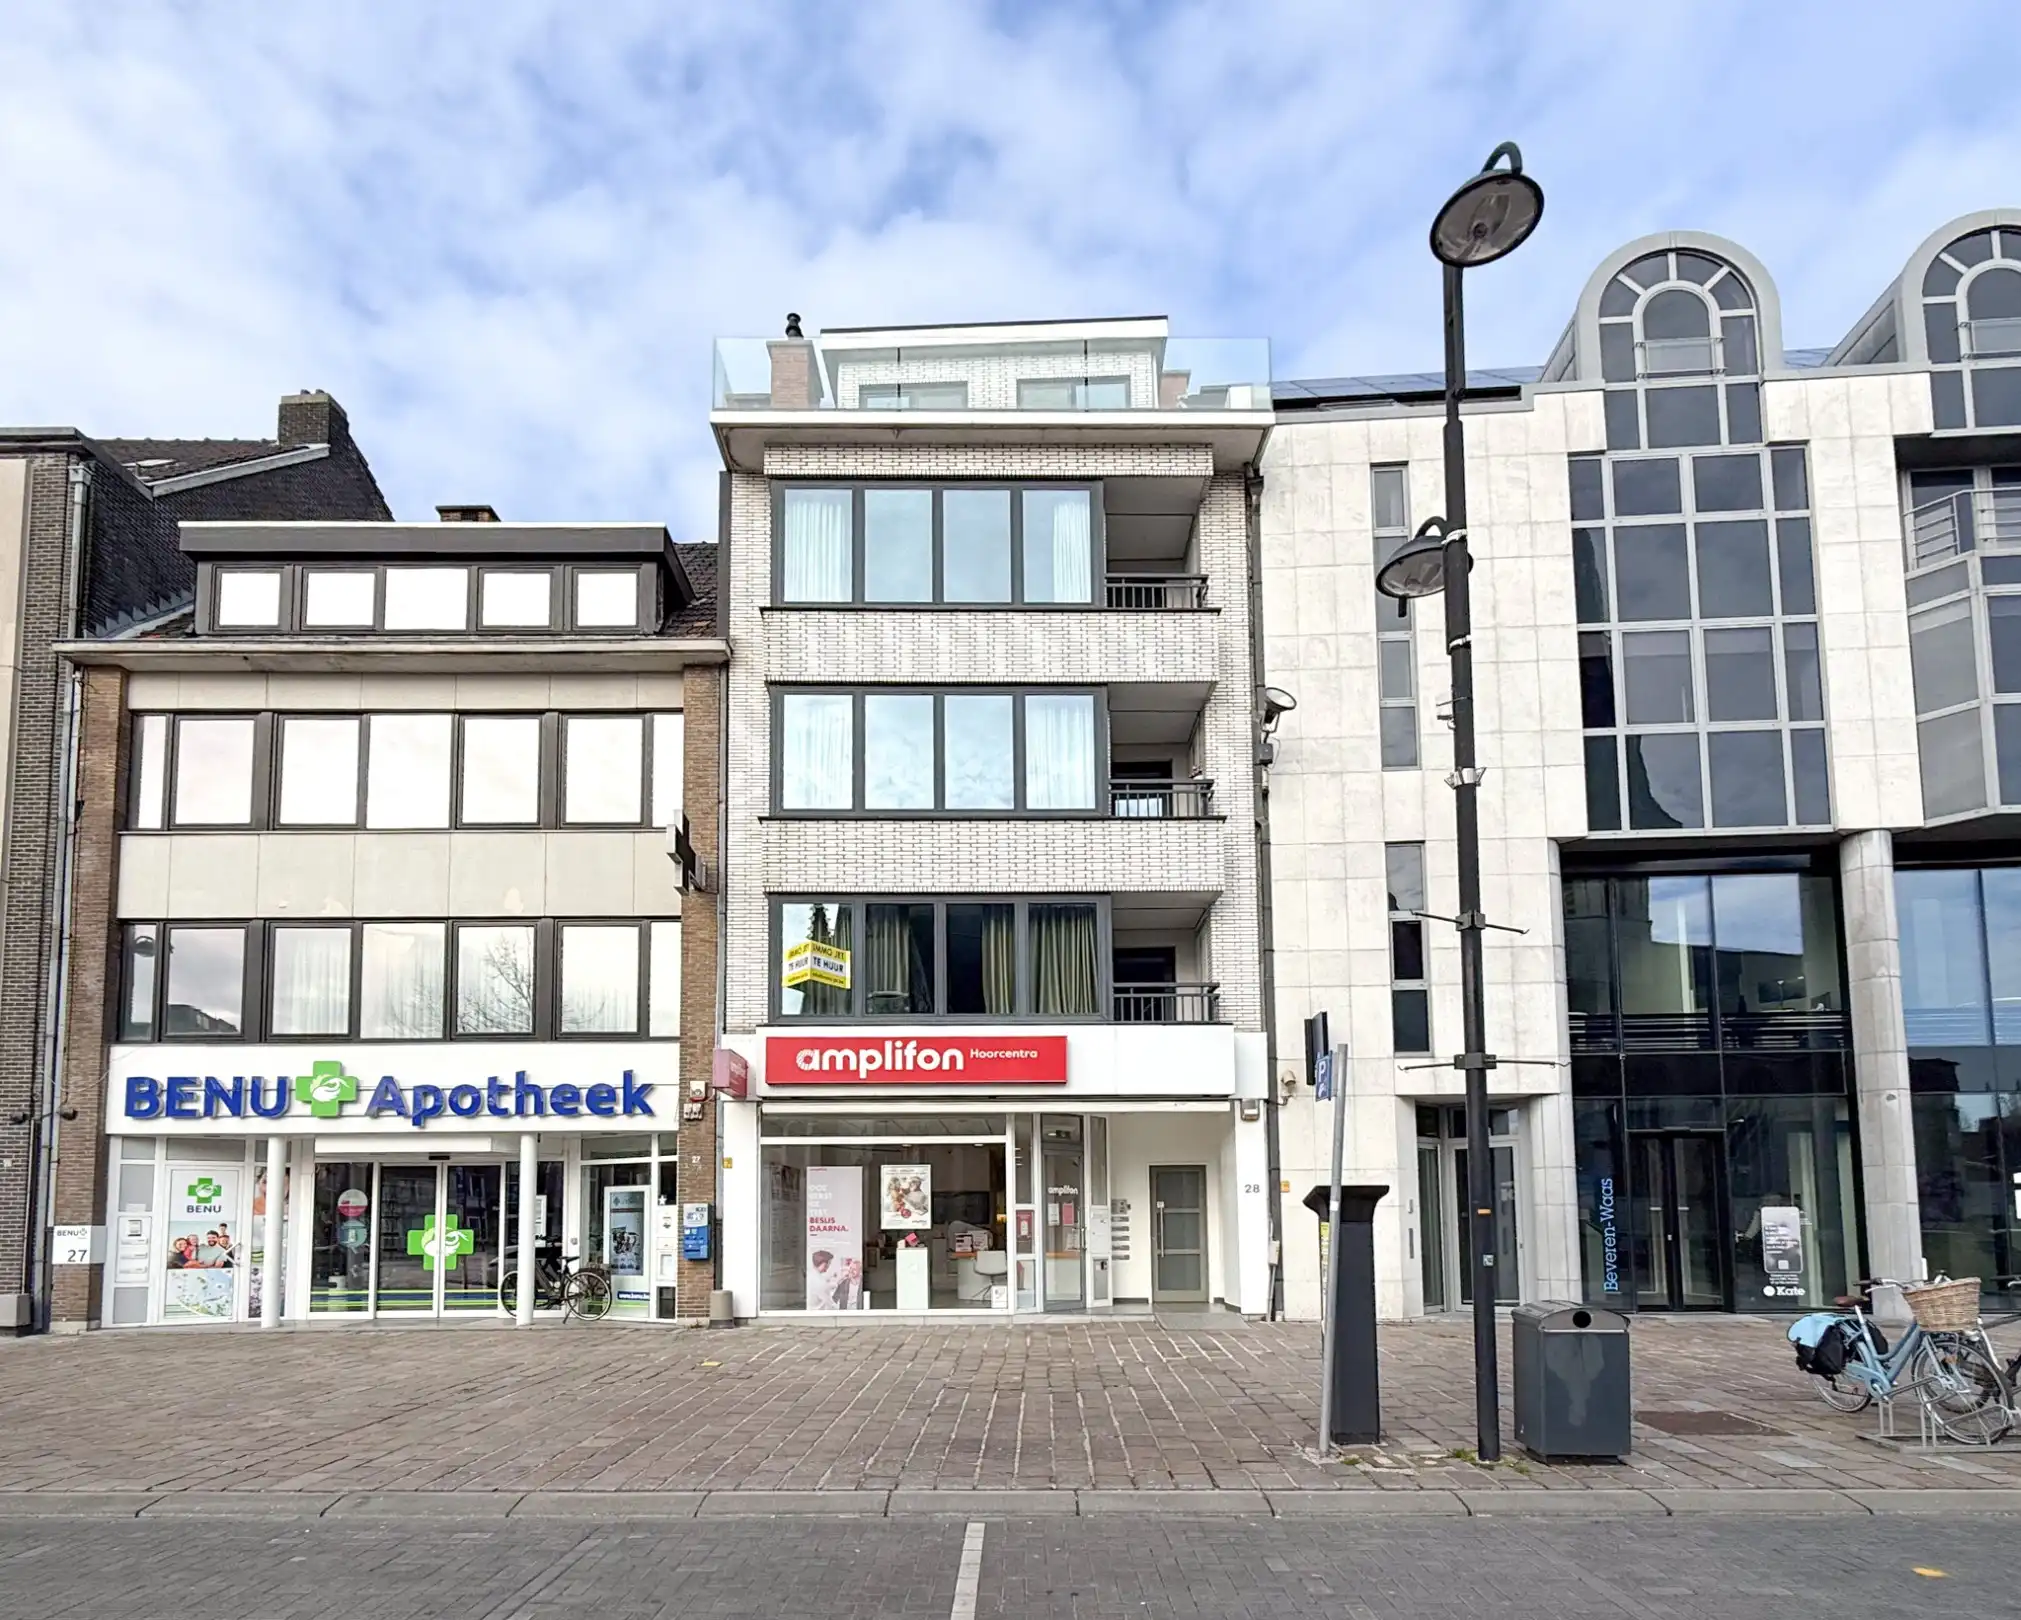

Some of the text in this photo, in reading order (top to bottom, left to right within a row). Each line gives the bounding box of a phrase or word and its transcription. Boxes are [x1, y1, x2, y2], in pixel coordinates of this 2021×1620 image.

[813, 956, 844, 972] TE HUUR
[796, 1040, 964, 1079] amplifon
[970, 1048, 1038, 1059] Hoorcentra
[124, 1070, 655, 1127] BENU Apotheek
[1244, 1183, 1260, 1193] 28
[186, 1205, 222, 1214] BENU
[56, 1229, 79, 1237] BENU
[1600, 1178, 1618, 1291] Beveren-Waas
[67, 1249, 88, 1262] 27
[1776, 1286, 1806, 1296] Kate
